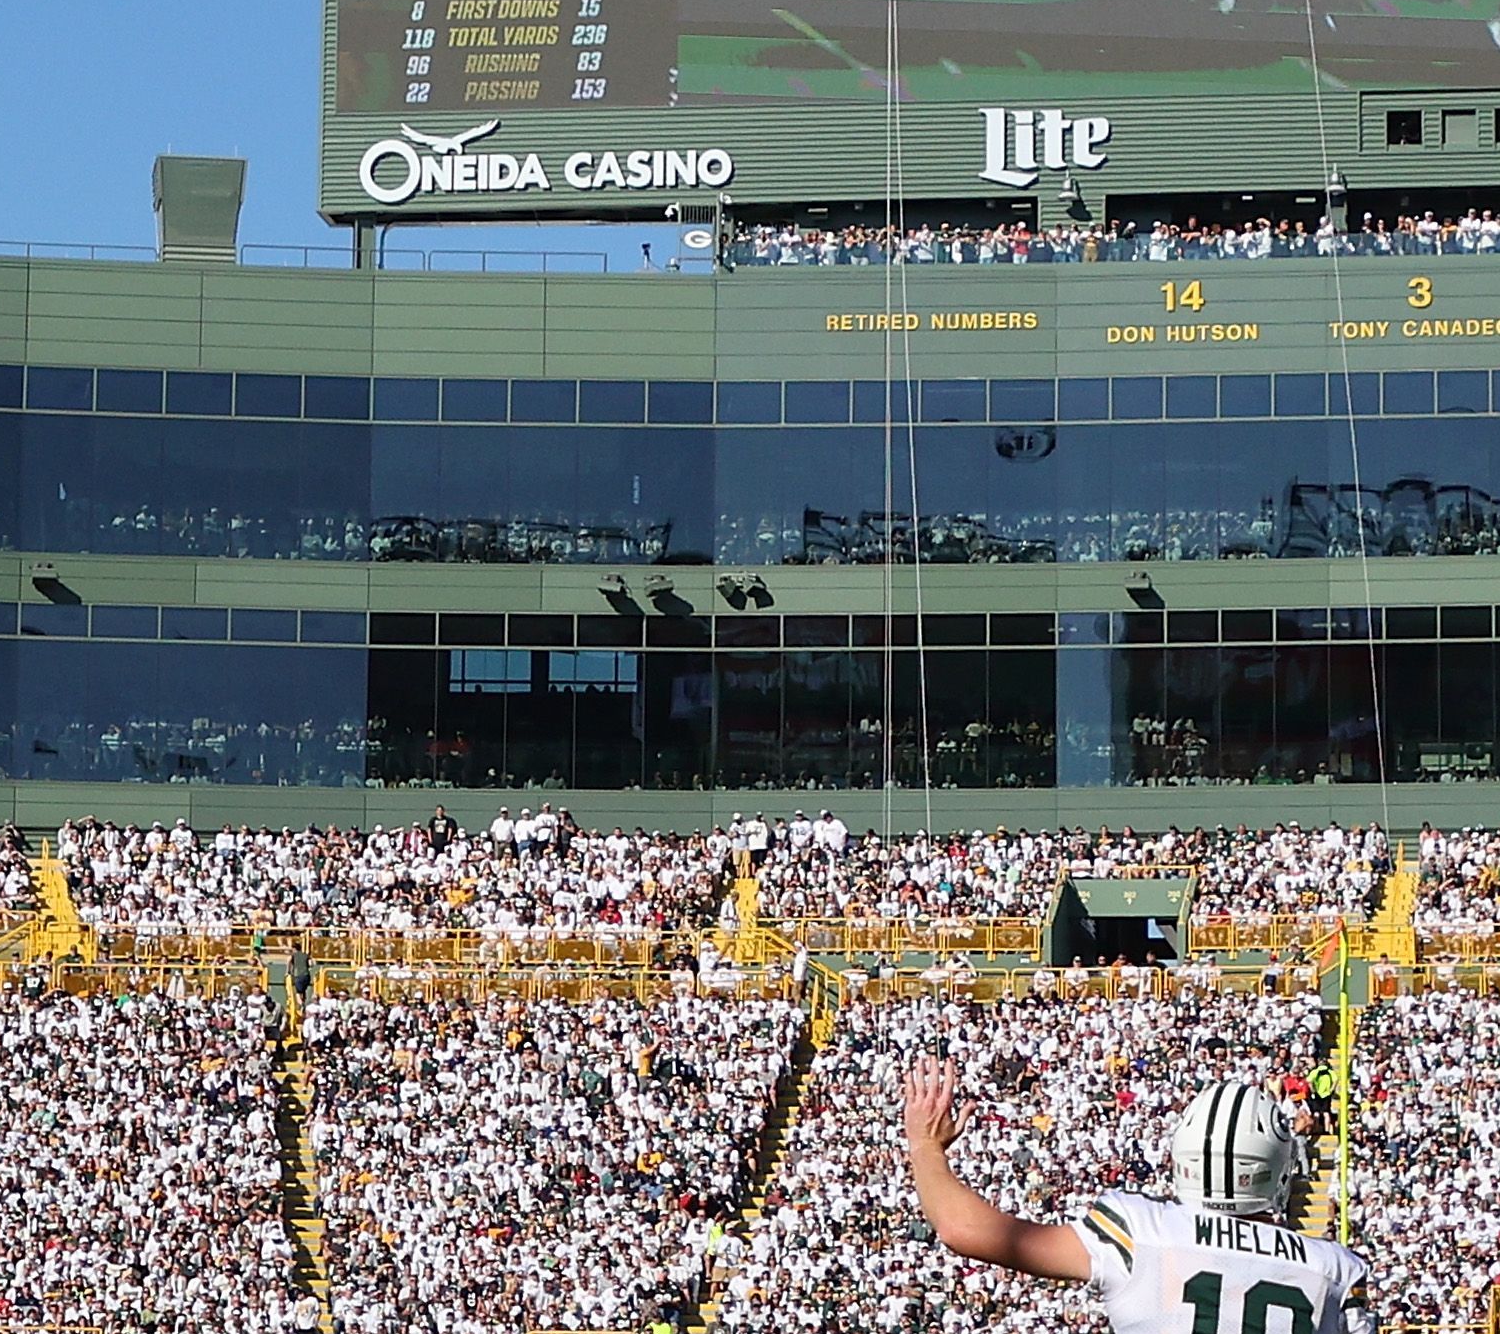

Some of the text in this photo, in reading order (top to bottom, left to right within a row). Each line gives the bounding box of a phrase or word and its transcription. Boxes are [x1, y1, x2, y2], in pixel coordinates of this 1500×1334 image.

[411, 0, 426, 21] 8
[446, 0, 495, 20] FIRST
[402, 24, 608, 50] 118 TOTAL YARDS 236
[406, 51, 603, 76] 96 RUSHING 83
[405, 77, 607, 103] 22 PASSING 153
[976, 105, 1111, 189] Lite
[359, 139, 734, 205] ONEIDA CASINO
[1160, 280, 1206, 313] 14
[1407, 276, 1434, 309] 3
[825, 311, 1039, 331] RETIRED NUMBERS
[1106, 322, 1259, 344] DON HUTSON
[1329, 321, 1396, 340] TONY
[1194, 1214, 1308, 1265] WHELAN
